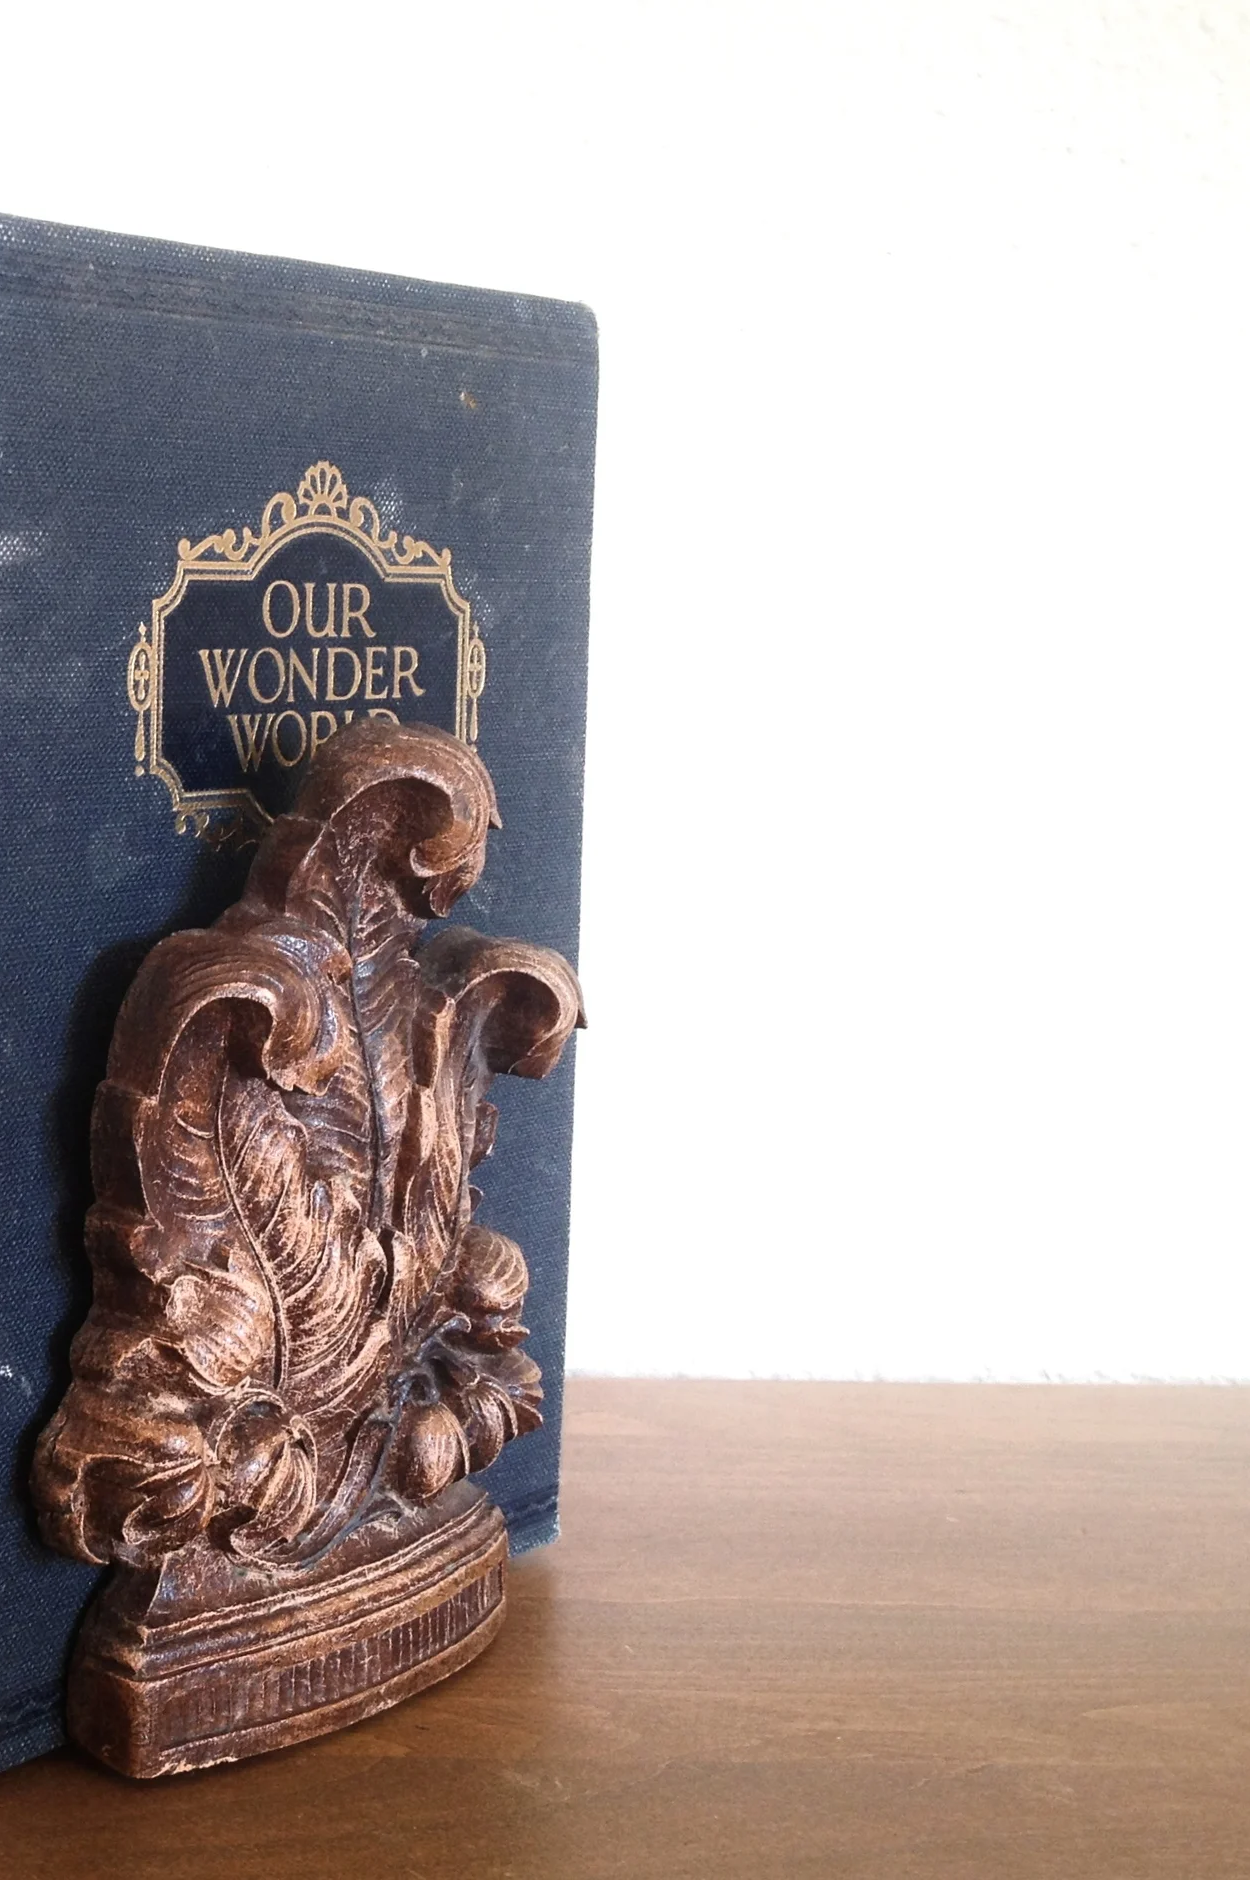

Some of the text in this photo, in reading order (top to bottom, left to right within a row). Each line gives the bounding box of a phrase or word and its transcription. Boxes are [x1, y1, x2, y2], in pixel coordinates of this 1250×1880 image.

[262, 580, 377, 639] OUR
[198, 646, 426, 708] WONDER
[226, 708, 401, 773] WOR
